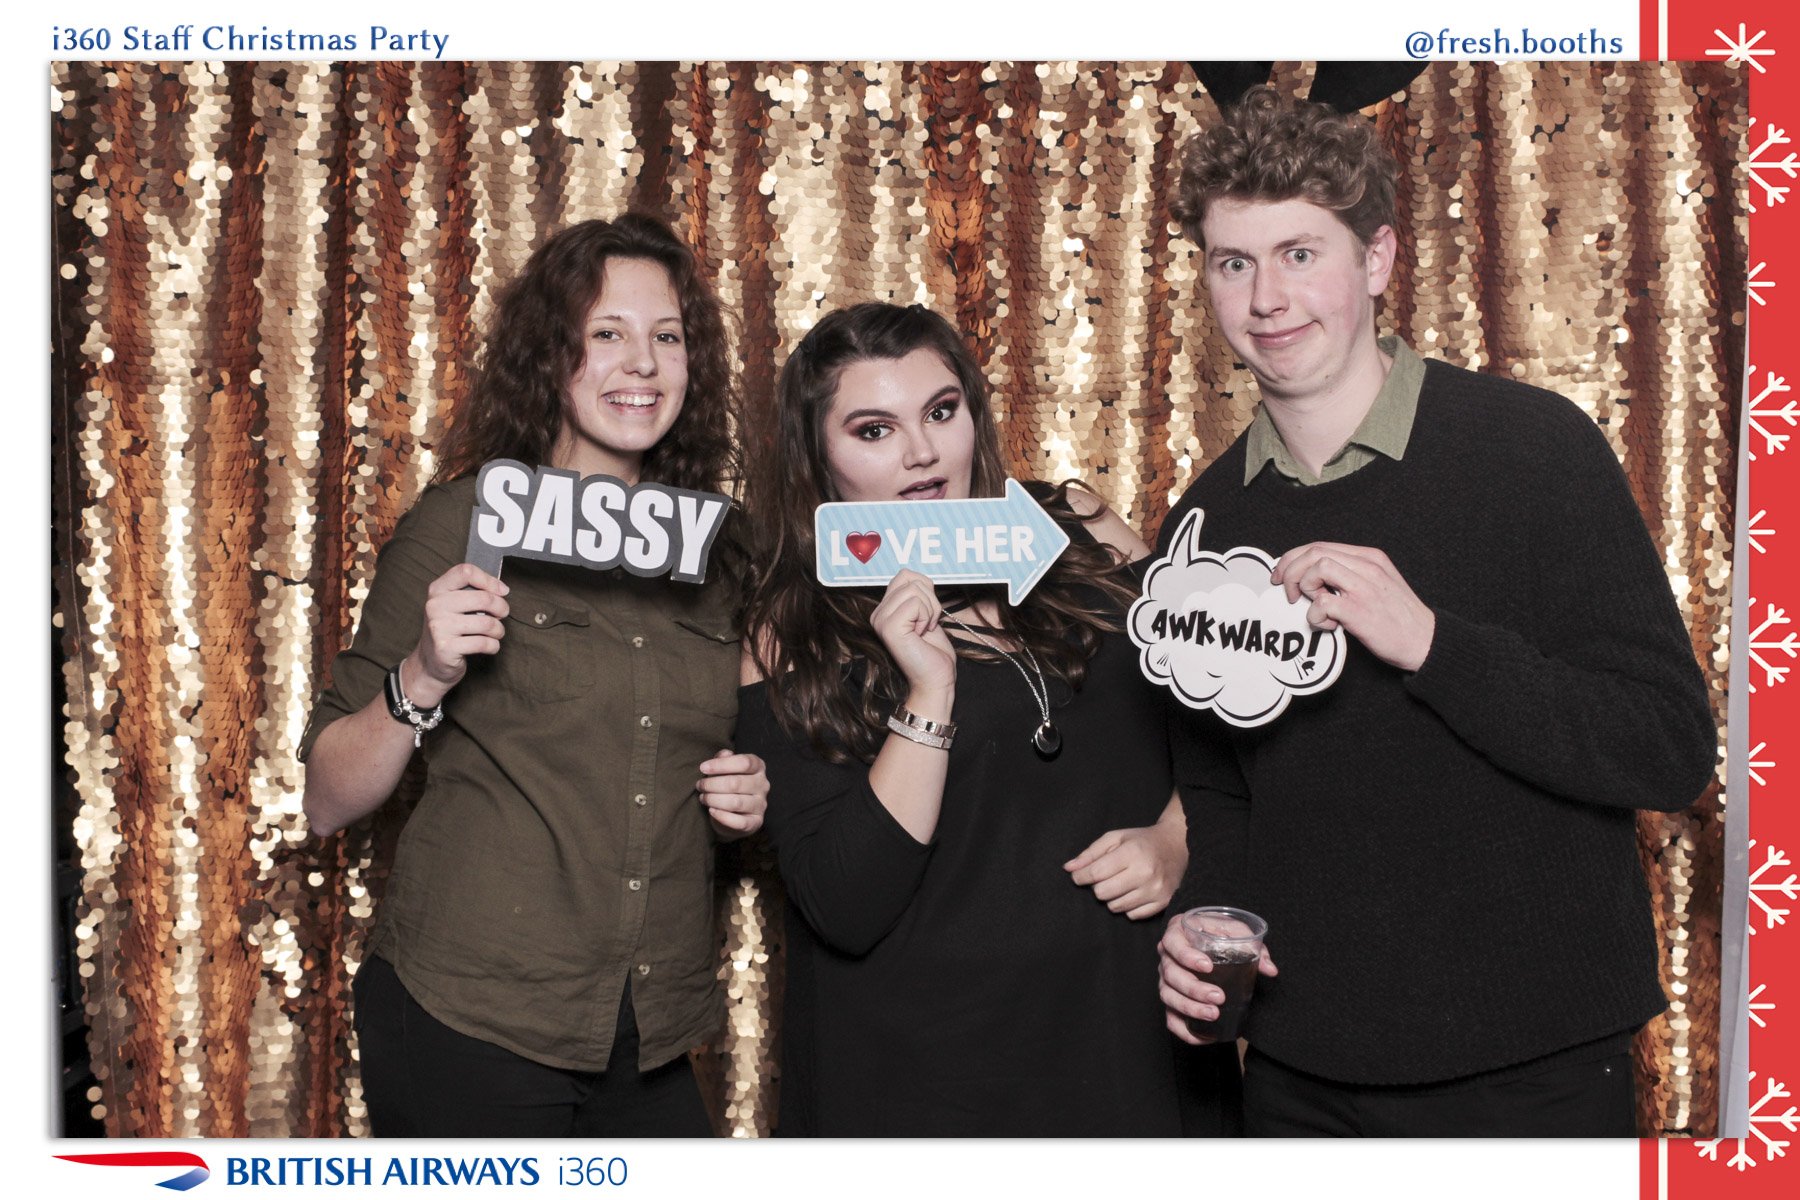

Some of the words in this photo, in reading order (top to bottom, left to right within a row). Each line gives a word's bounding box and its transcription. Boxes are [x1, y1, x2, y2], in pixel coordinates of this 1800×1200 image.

[477, 465, 723, 576] SASSY
[955, 525, 1037, 564] HER
[1151, 608, 1323, 673] AWKWARD!
